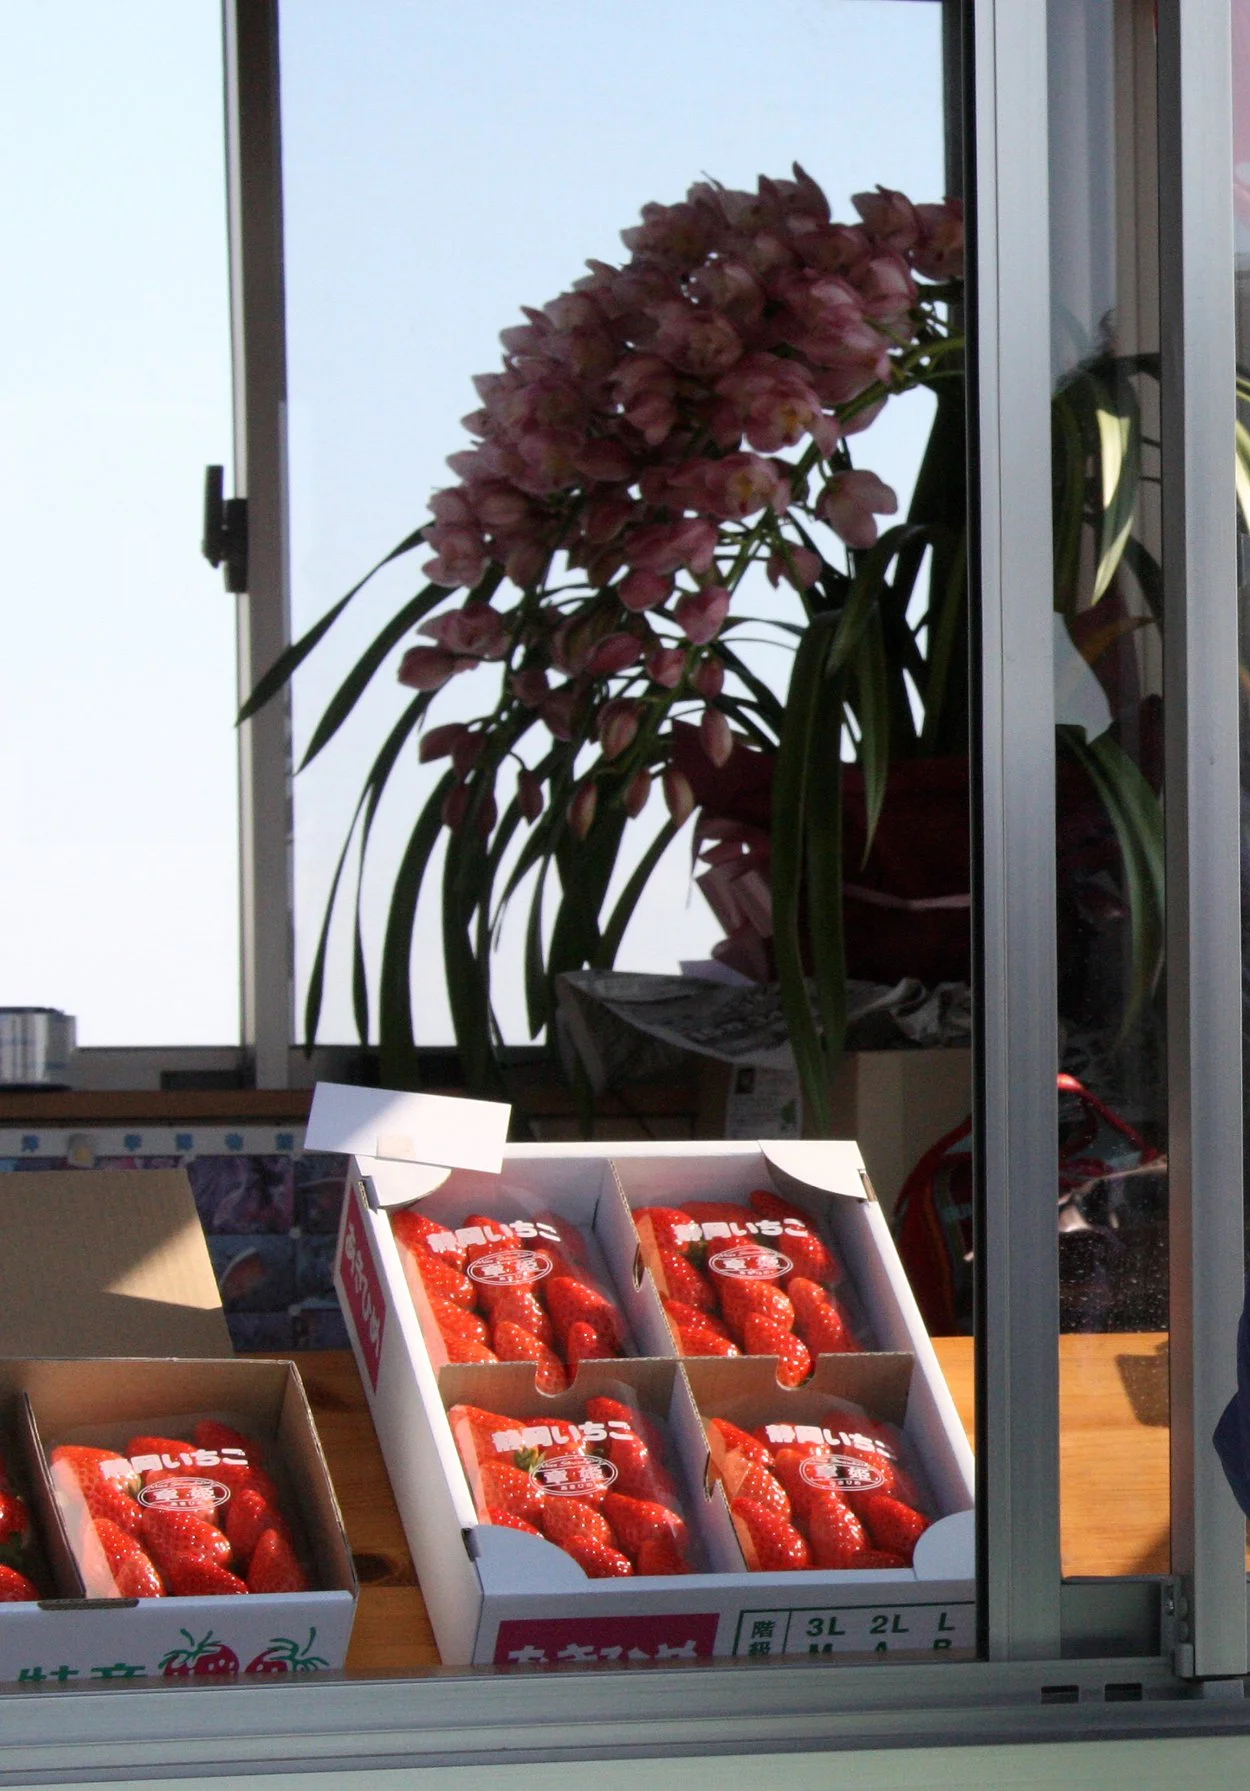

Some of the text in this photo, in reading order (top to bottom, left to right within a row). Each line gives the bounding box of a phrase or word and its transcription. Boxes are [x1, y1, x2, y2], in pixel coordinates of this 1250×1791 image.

[806, 1612, 956, 1637] 3L 2L L
